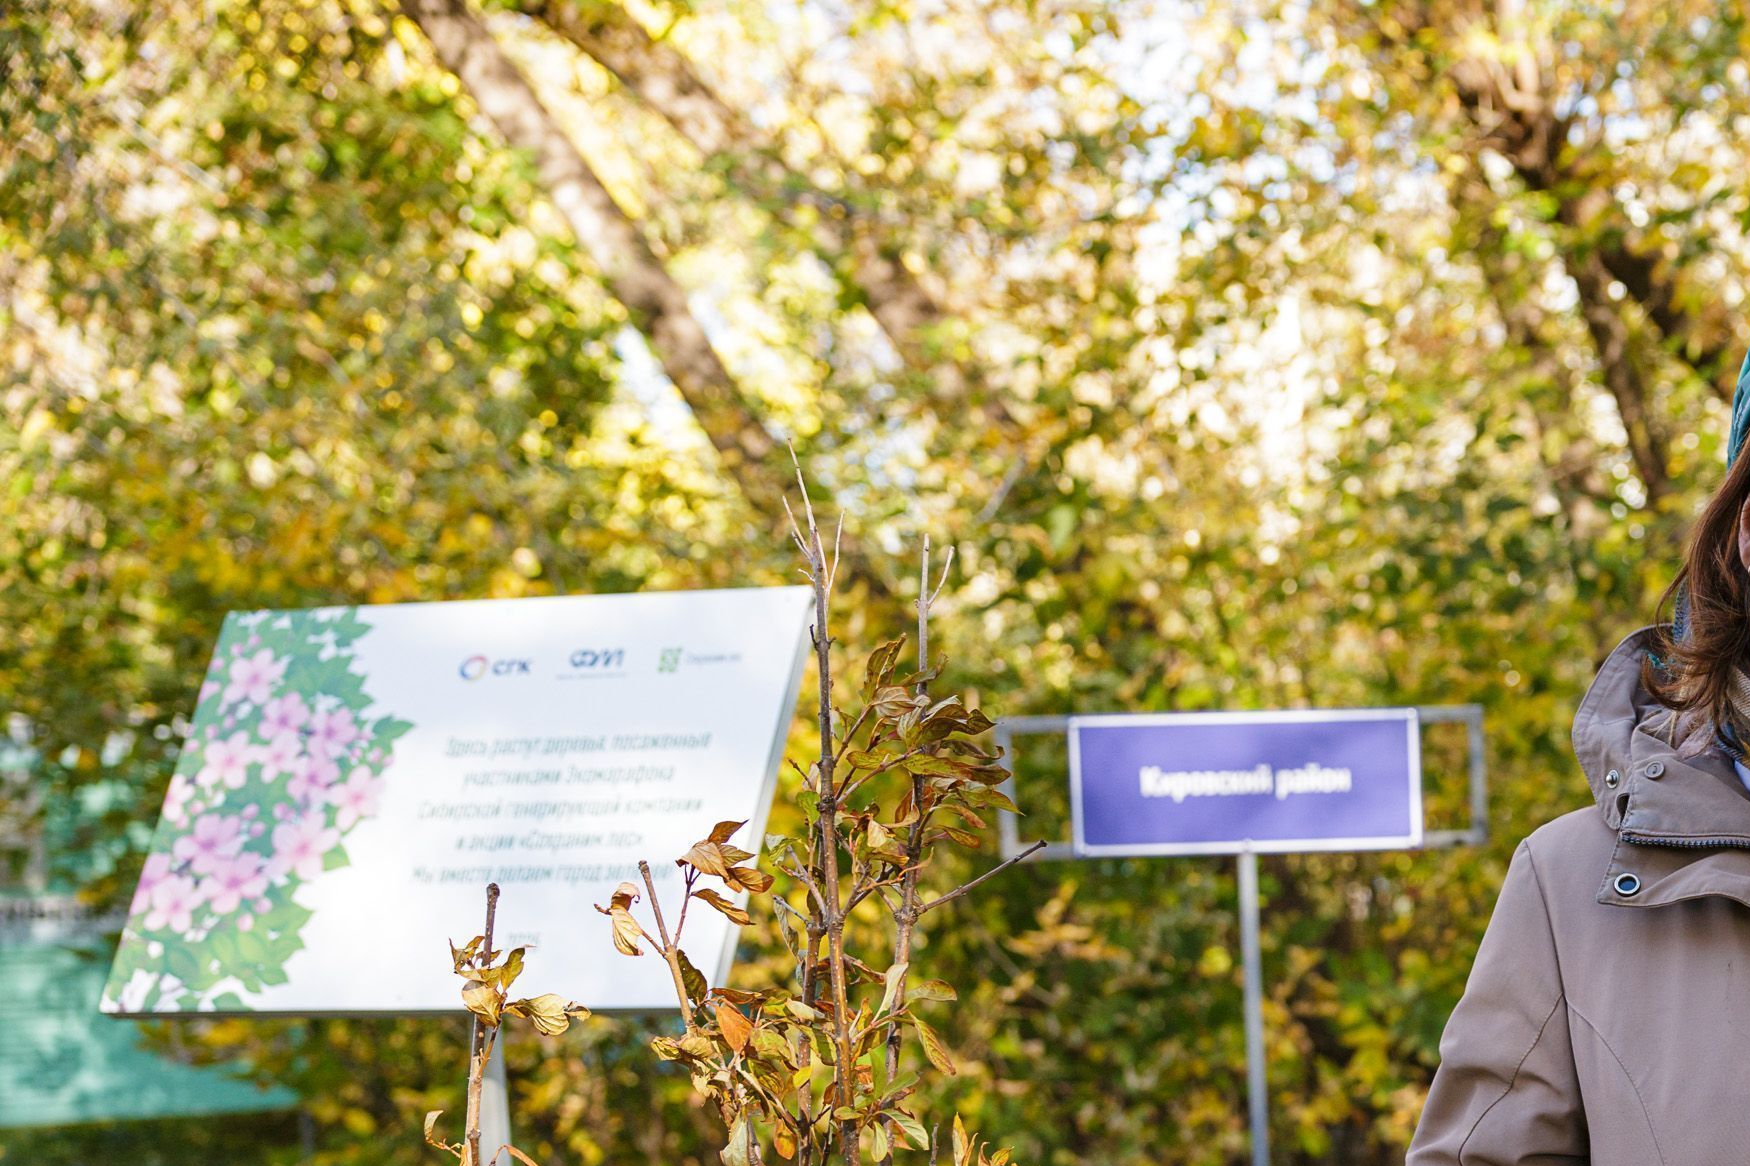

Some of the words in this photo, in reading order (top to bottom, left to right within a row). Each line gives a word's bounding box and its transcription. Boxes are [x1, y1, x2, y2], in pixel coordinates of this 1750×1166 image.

[446, 736, 488, 758] Здесь
[490, 736, 541, 760] растут
[1140, 764, 1273, 803] Кировский
[1275, 763, 1352, 800] район
[417, 797, 502, 822] Сибирской
[506, 795, 621, 819] генерирующей
